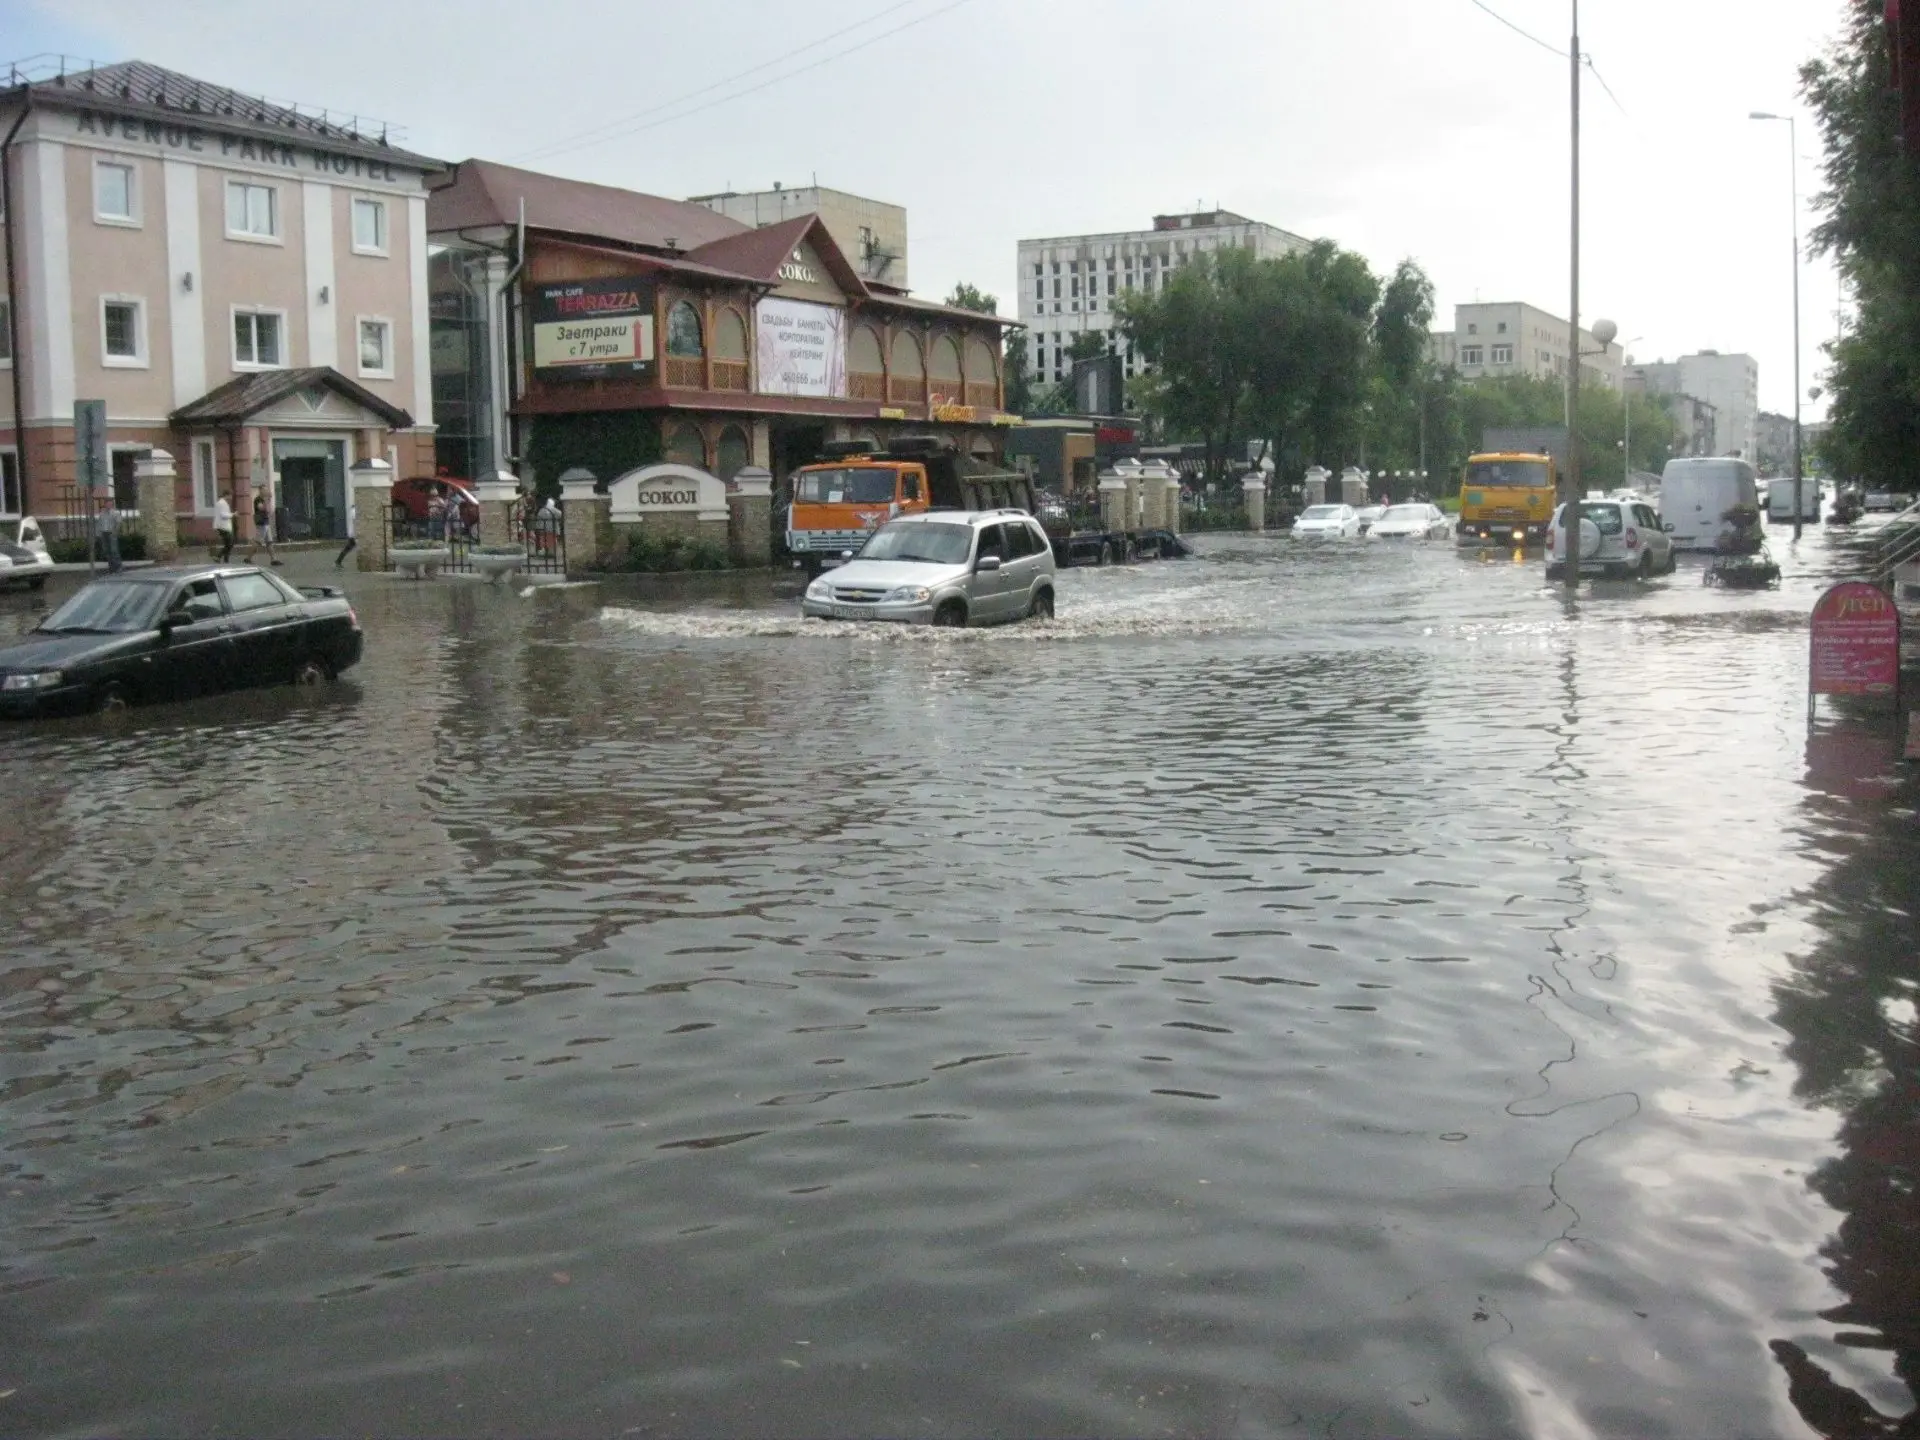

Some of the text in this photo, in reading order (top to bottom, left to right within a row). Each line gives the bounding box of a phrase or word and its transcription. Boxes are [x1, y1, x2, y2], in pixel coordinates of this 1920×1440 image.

[77, 111, 397, 183] AVENUE PARK HOTEL
[555, 291, 640, 315] TERRAZZA
[762, 314, 826, 332] СВАДЬБЫ БАНКЕТЫ
[556, 325, 628, 341] Завтраки
[779, 331, 825, 345] КОРПОРАТИВЫ
[569, 341, 619, 357] с 7 утра
[639, 490, 697, 504] СОКОЛ
